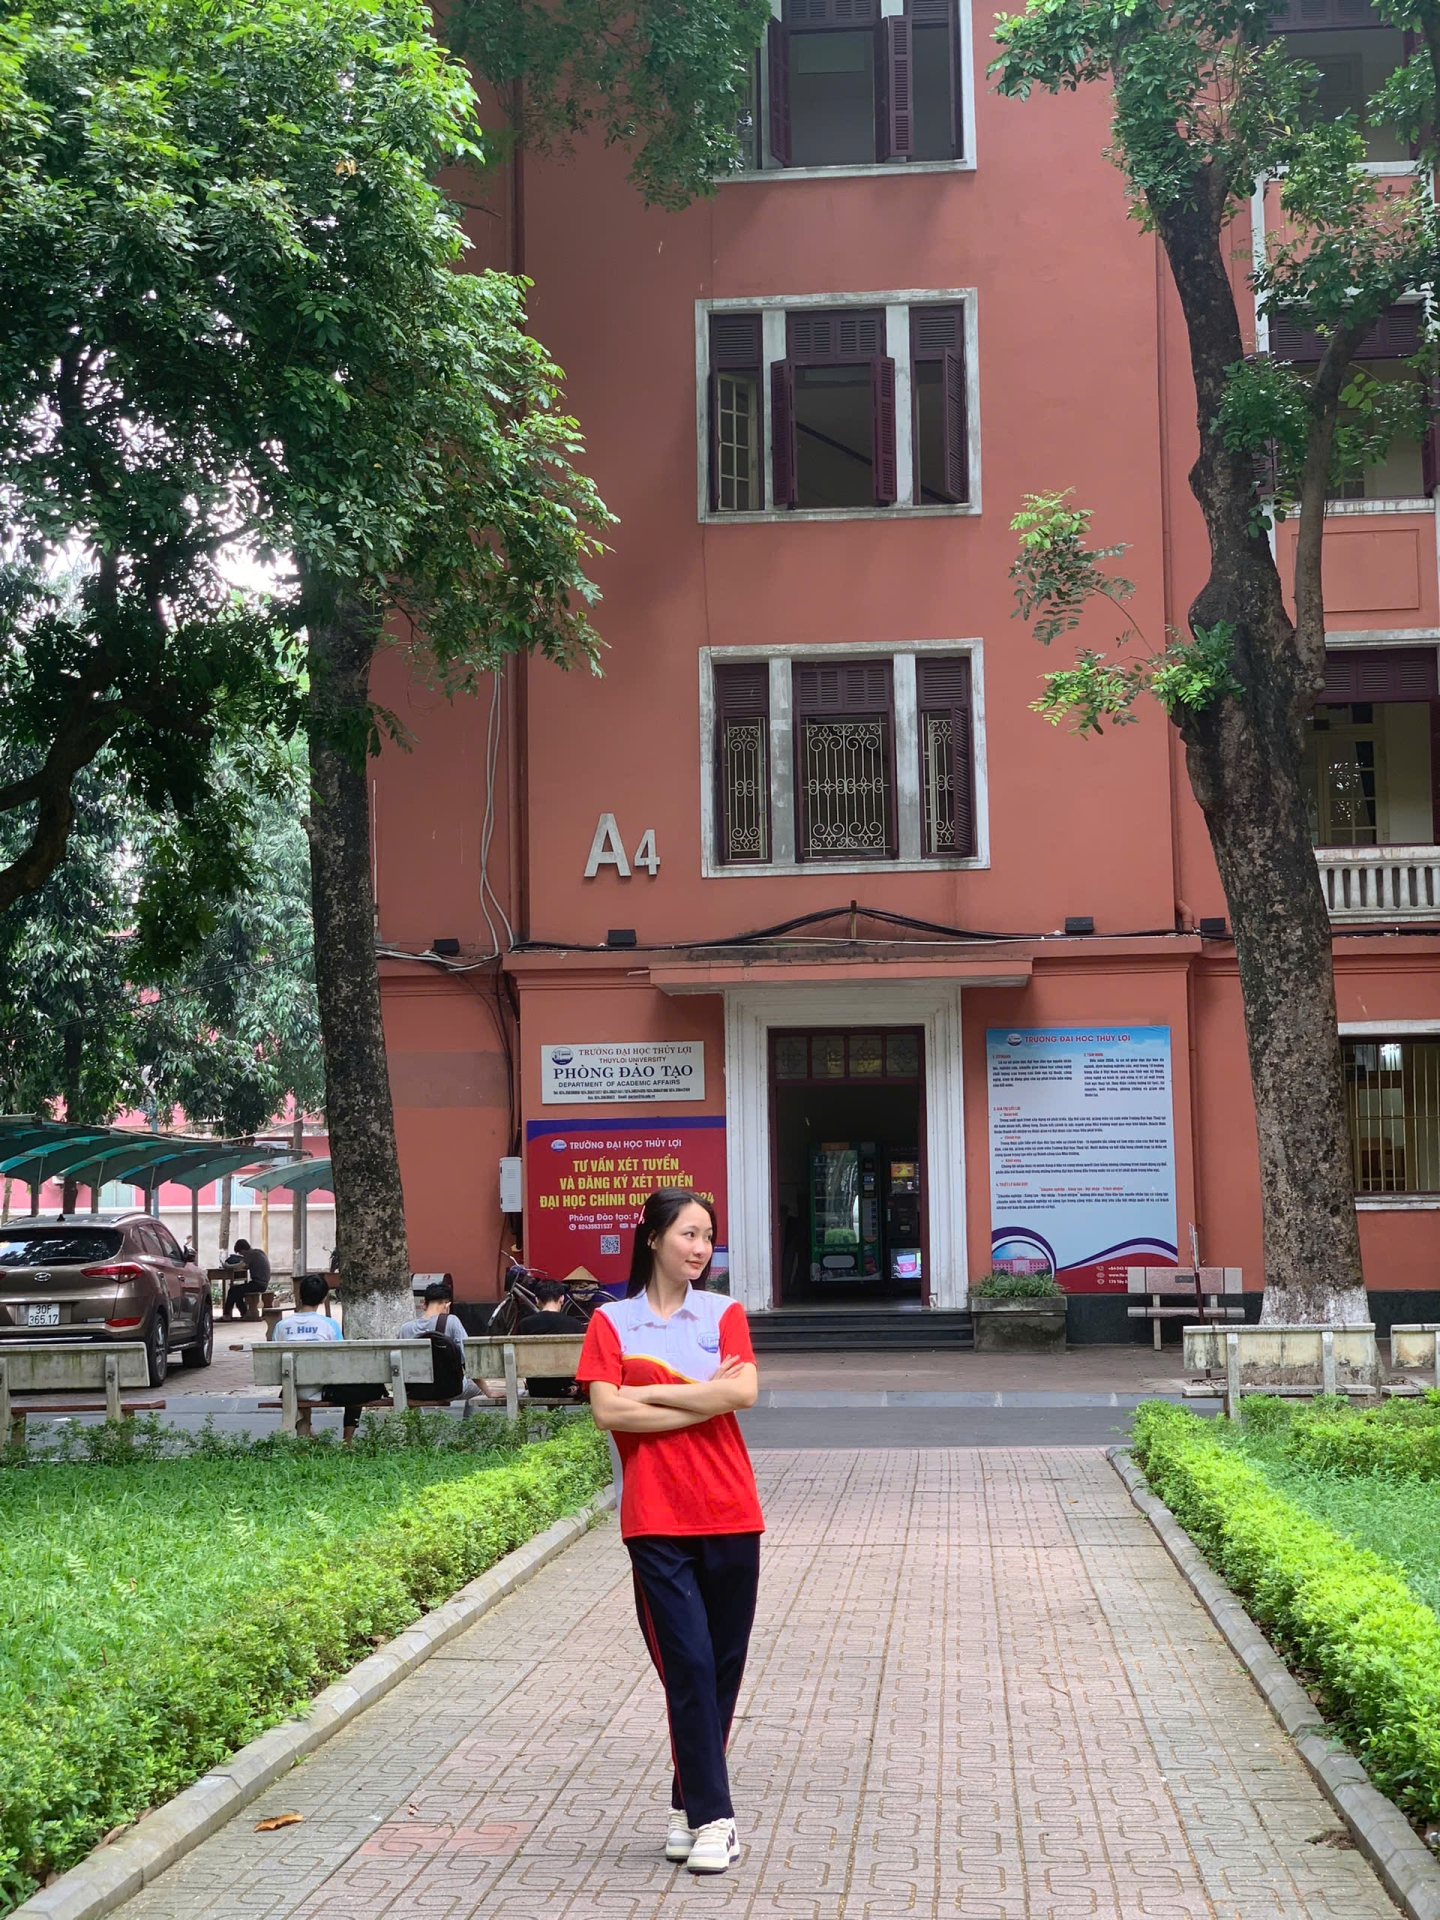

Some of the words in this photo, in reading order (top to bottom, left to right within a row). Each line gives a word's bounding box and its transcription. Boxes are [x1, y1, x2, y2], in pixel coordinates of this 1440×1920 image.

[583, 812, 661, 878] A4
[615, 1048, 631, 1056] ĐẠI
[633, 1047, 651, 1055] HỌC
[677, 1046, 692, 1055] LỢI
[553, 1065, 614, 1079] PHÒNG
[619, 1063, 655, 1078] ĐÀO
[660, 1064, 693, 1079] TẠO
[569, 1141, 604, 1150] TRƯỜNG
[606, 1141, 622, 1150] ĐẠI
[623, 1141, 643, 1150] HỌC
[645, 1138, 665, 1147] THỦY
[668, 1139, 682, 1148] LỢI
[573, 1159, 588, 1172] TƯ
[591, 1156, 614, 1171] VẤN
[617, 1157, 638, 1171] XÉT
[642, 1154, 679, 1171] TUYỂN
[559, 1177, 575, 1190] VÀ
[577, 1177, 610, 1189] ĐĂNG
[613, 1174, 628, 1188] KÝ
[631, 1173, 653, 1187] XÉT
[656, 1170, 693, 1187] TUYỂN
[539, 1195, 559, 1209] ĐẠI
[562, 1194, 586, 1209] HỌC
[590, 1192, 625, 1206] CHÍNH
[569, 1213, 594, 1223] Phòng
[596, 1212, 614, 1221] Đào
[615, 1212, 631, 1222] tạo:
[35, 1304, 53, 1314] 30F
[29, 1314, 59, 1325] 365.17
[297, 1326, 319, 1334] Huy
